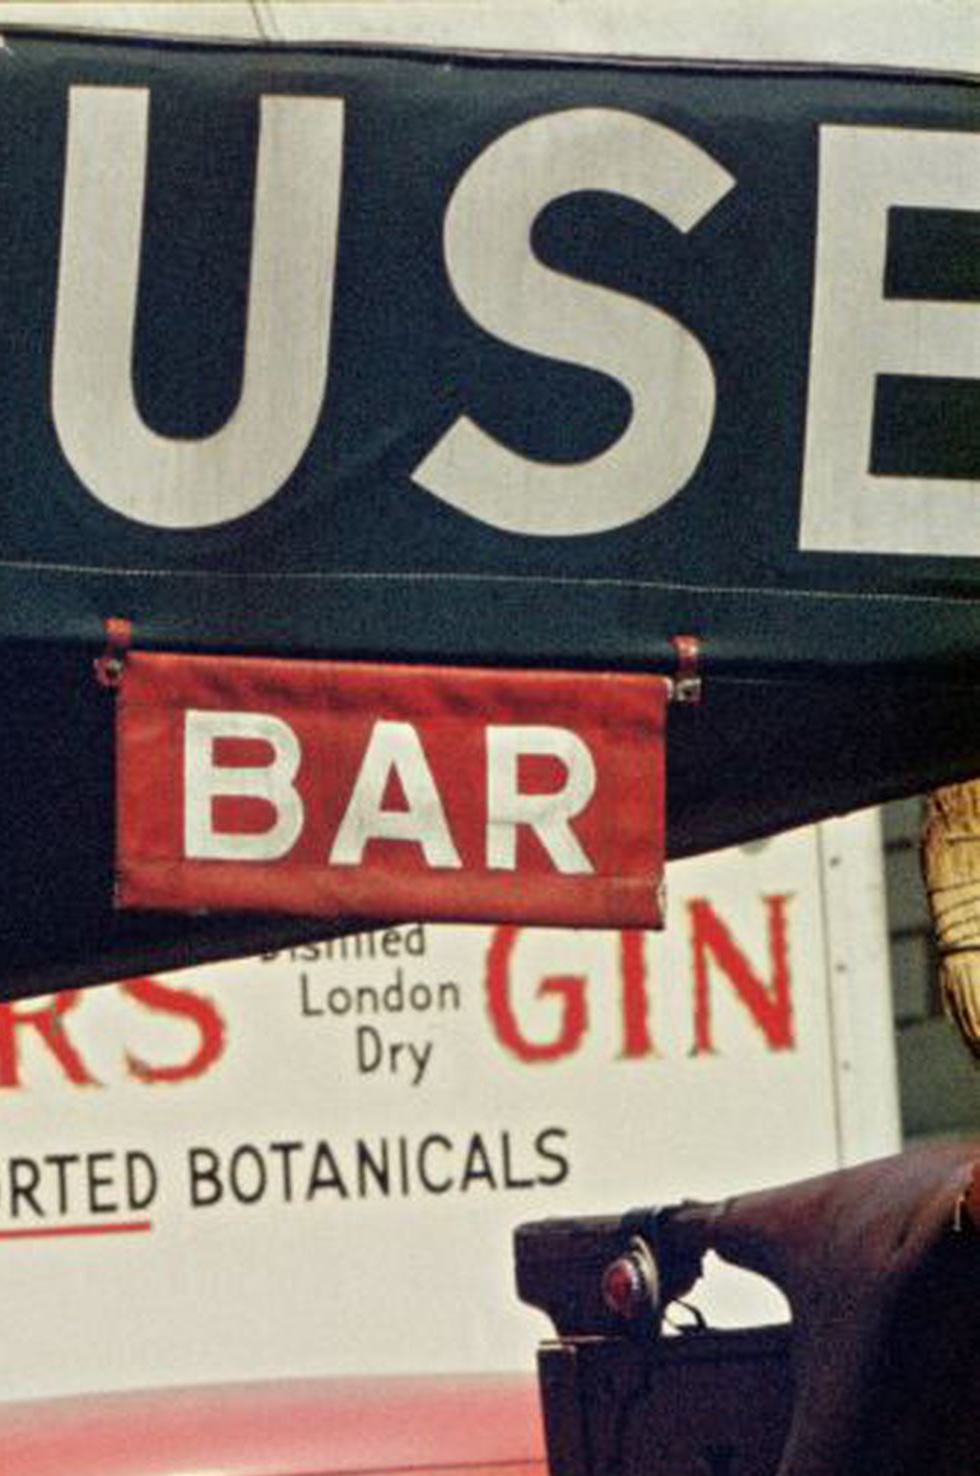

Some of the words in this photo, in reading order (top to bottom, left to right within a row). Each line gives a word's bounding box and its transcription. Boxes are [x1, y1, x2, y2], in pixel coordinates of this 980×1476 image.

[183, 709, 598, 875] BAR
[300, 969, 461, 1018] London
[486, 894, 798, 1064] GIN
[356, 1025, 434, 1087] Dry
[188, 1128, 571, 1210] BOTANICALS
